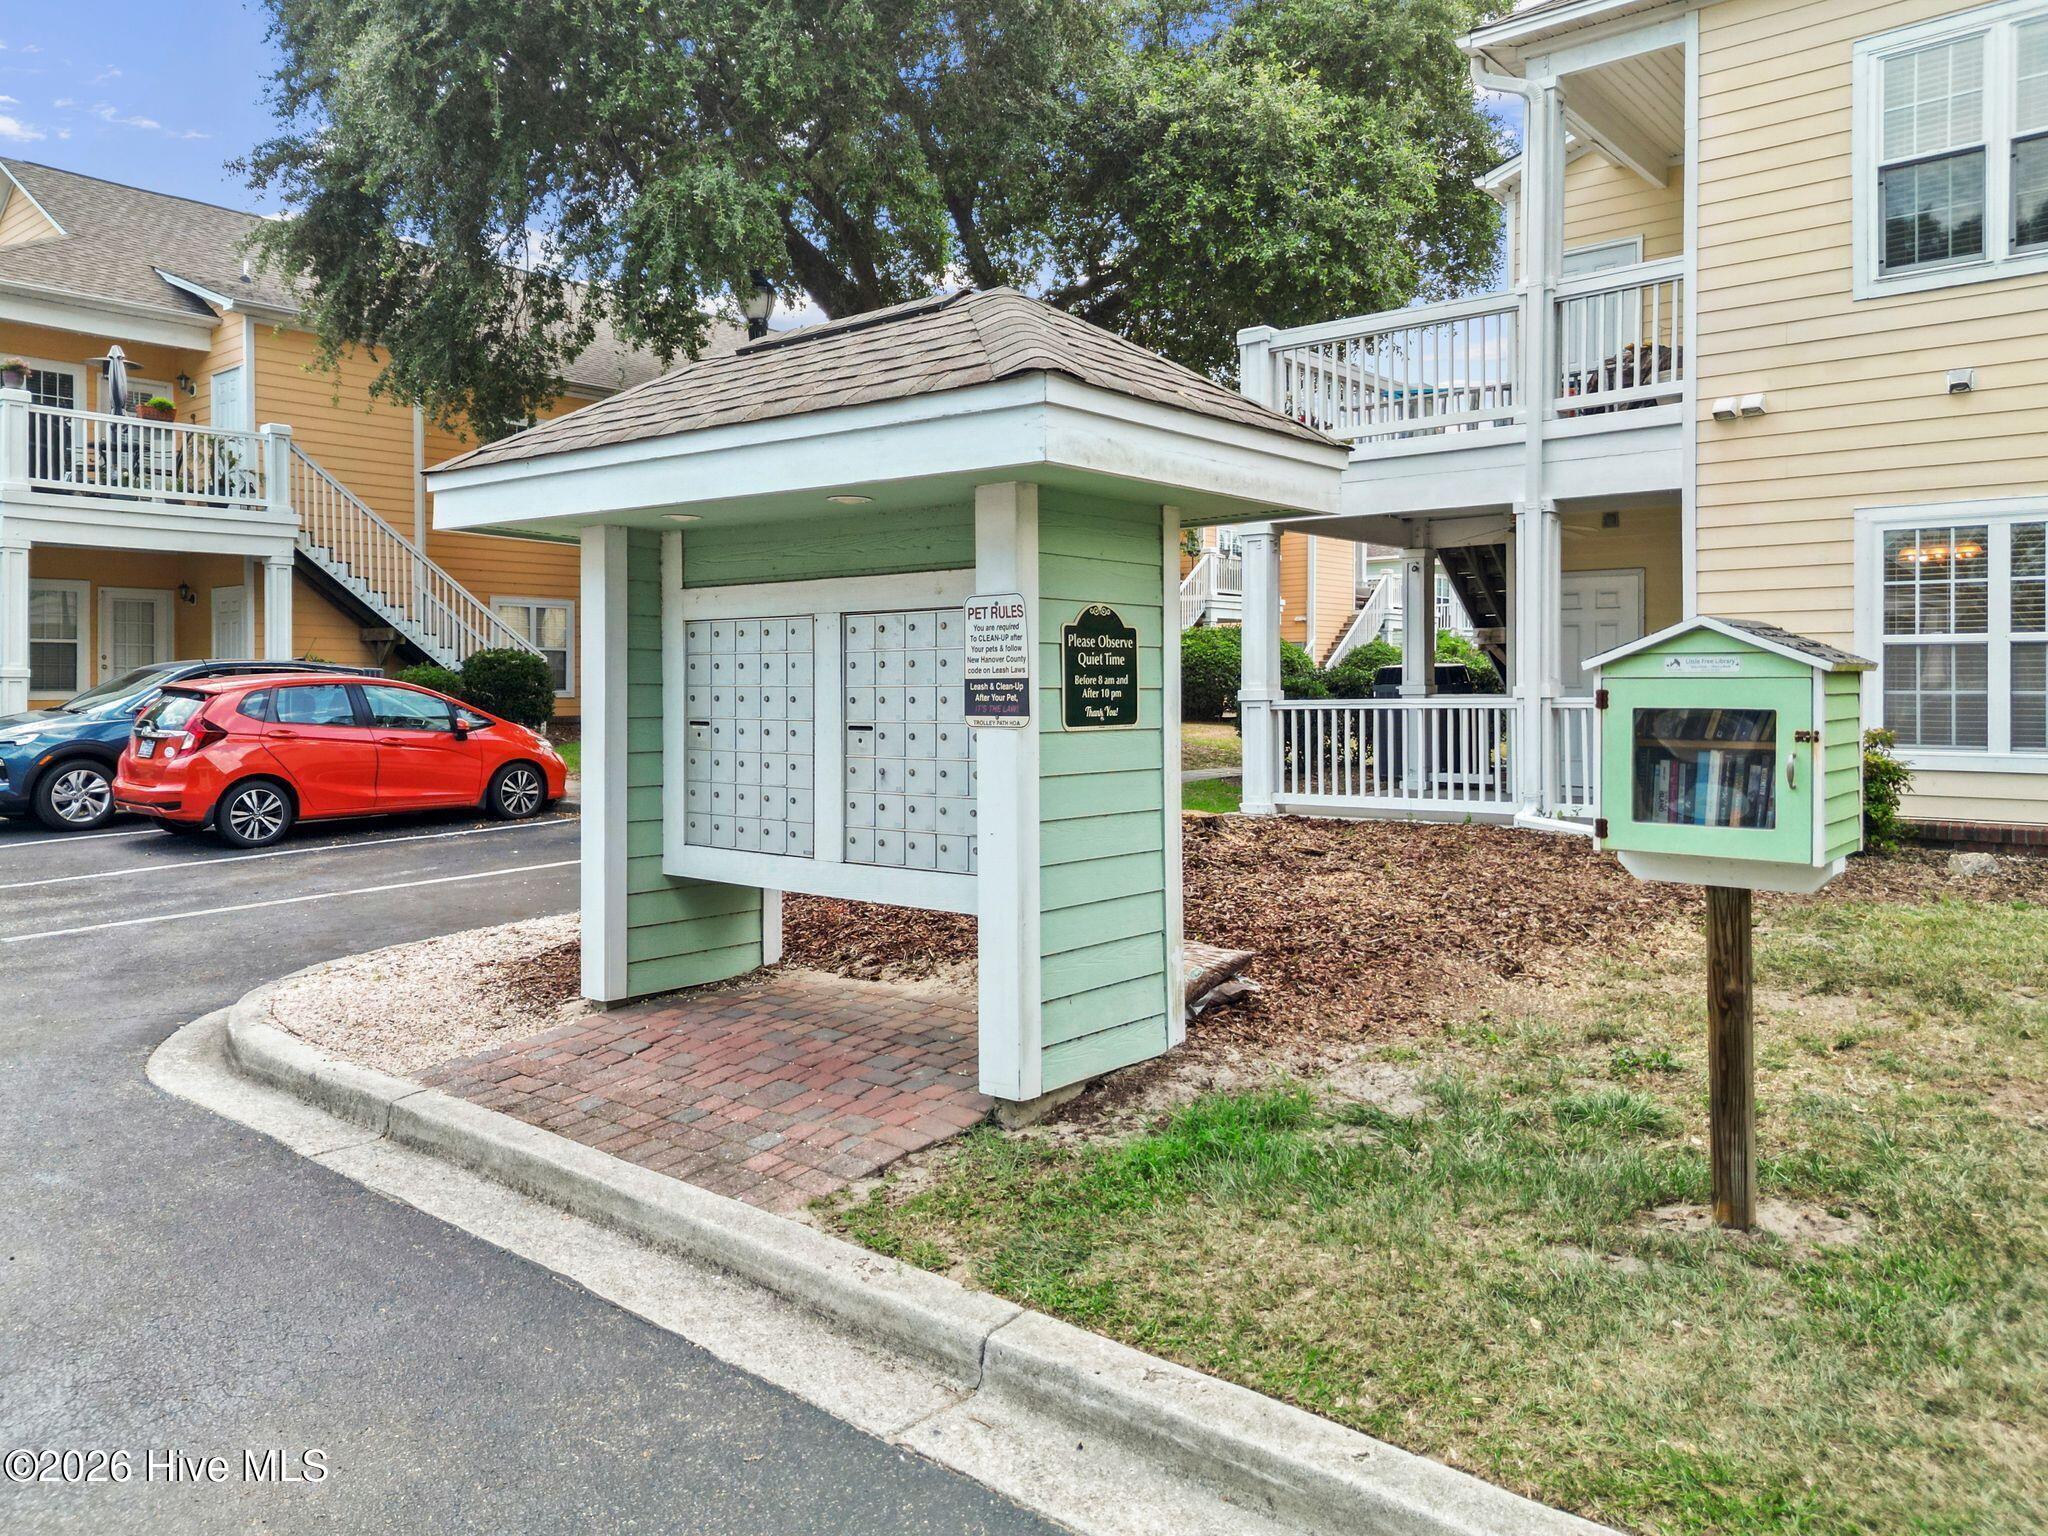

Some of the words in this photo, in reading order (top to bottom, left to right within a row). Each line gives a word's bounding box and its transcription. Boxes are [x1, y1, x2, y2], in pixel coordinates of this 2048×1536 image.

[968, 606, 988, 620] PET
[991, 604, 1024, 619] RULES
[996, 622, 1020, 632] required
[978, 634, 1009, 642] CLEAN-UP
[1068, 634, 1096, 648] Please
[1098, 634, 1133, 648] Observe
[986, 646, 998, 654] pets
[1006, 655, 1026, 664] County
[1078, 652, 1104, 668] Quiet
[1104, 652, 1125, 666] Time
[1074, 674, 1096, 684] Before
[1098, 674, 1103, 684] 8
[1116, 674, 1128, 684] and
[996, 682, 1024, 692] Clean-Up
[1082, 688, 1099, 698] After
[1100, 688, 1110, 698] 10
[1110, 690, 1122, 700] pm
[1084, 706, 1104, 718] Thank
[1104, 706, 1118, 716] You!
